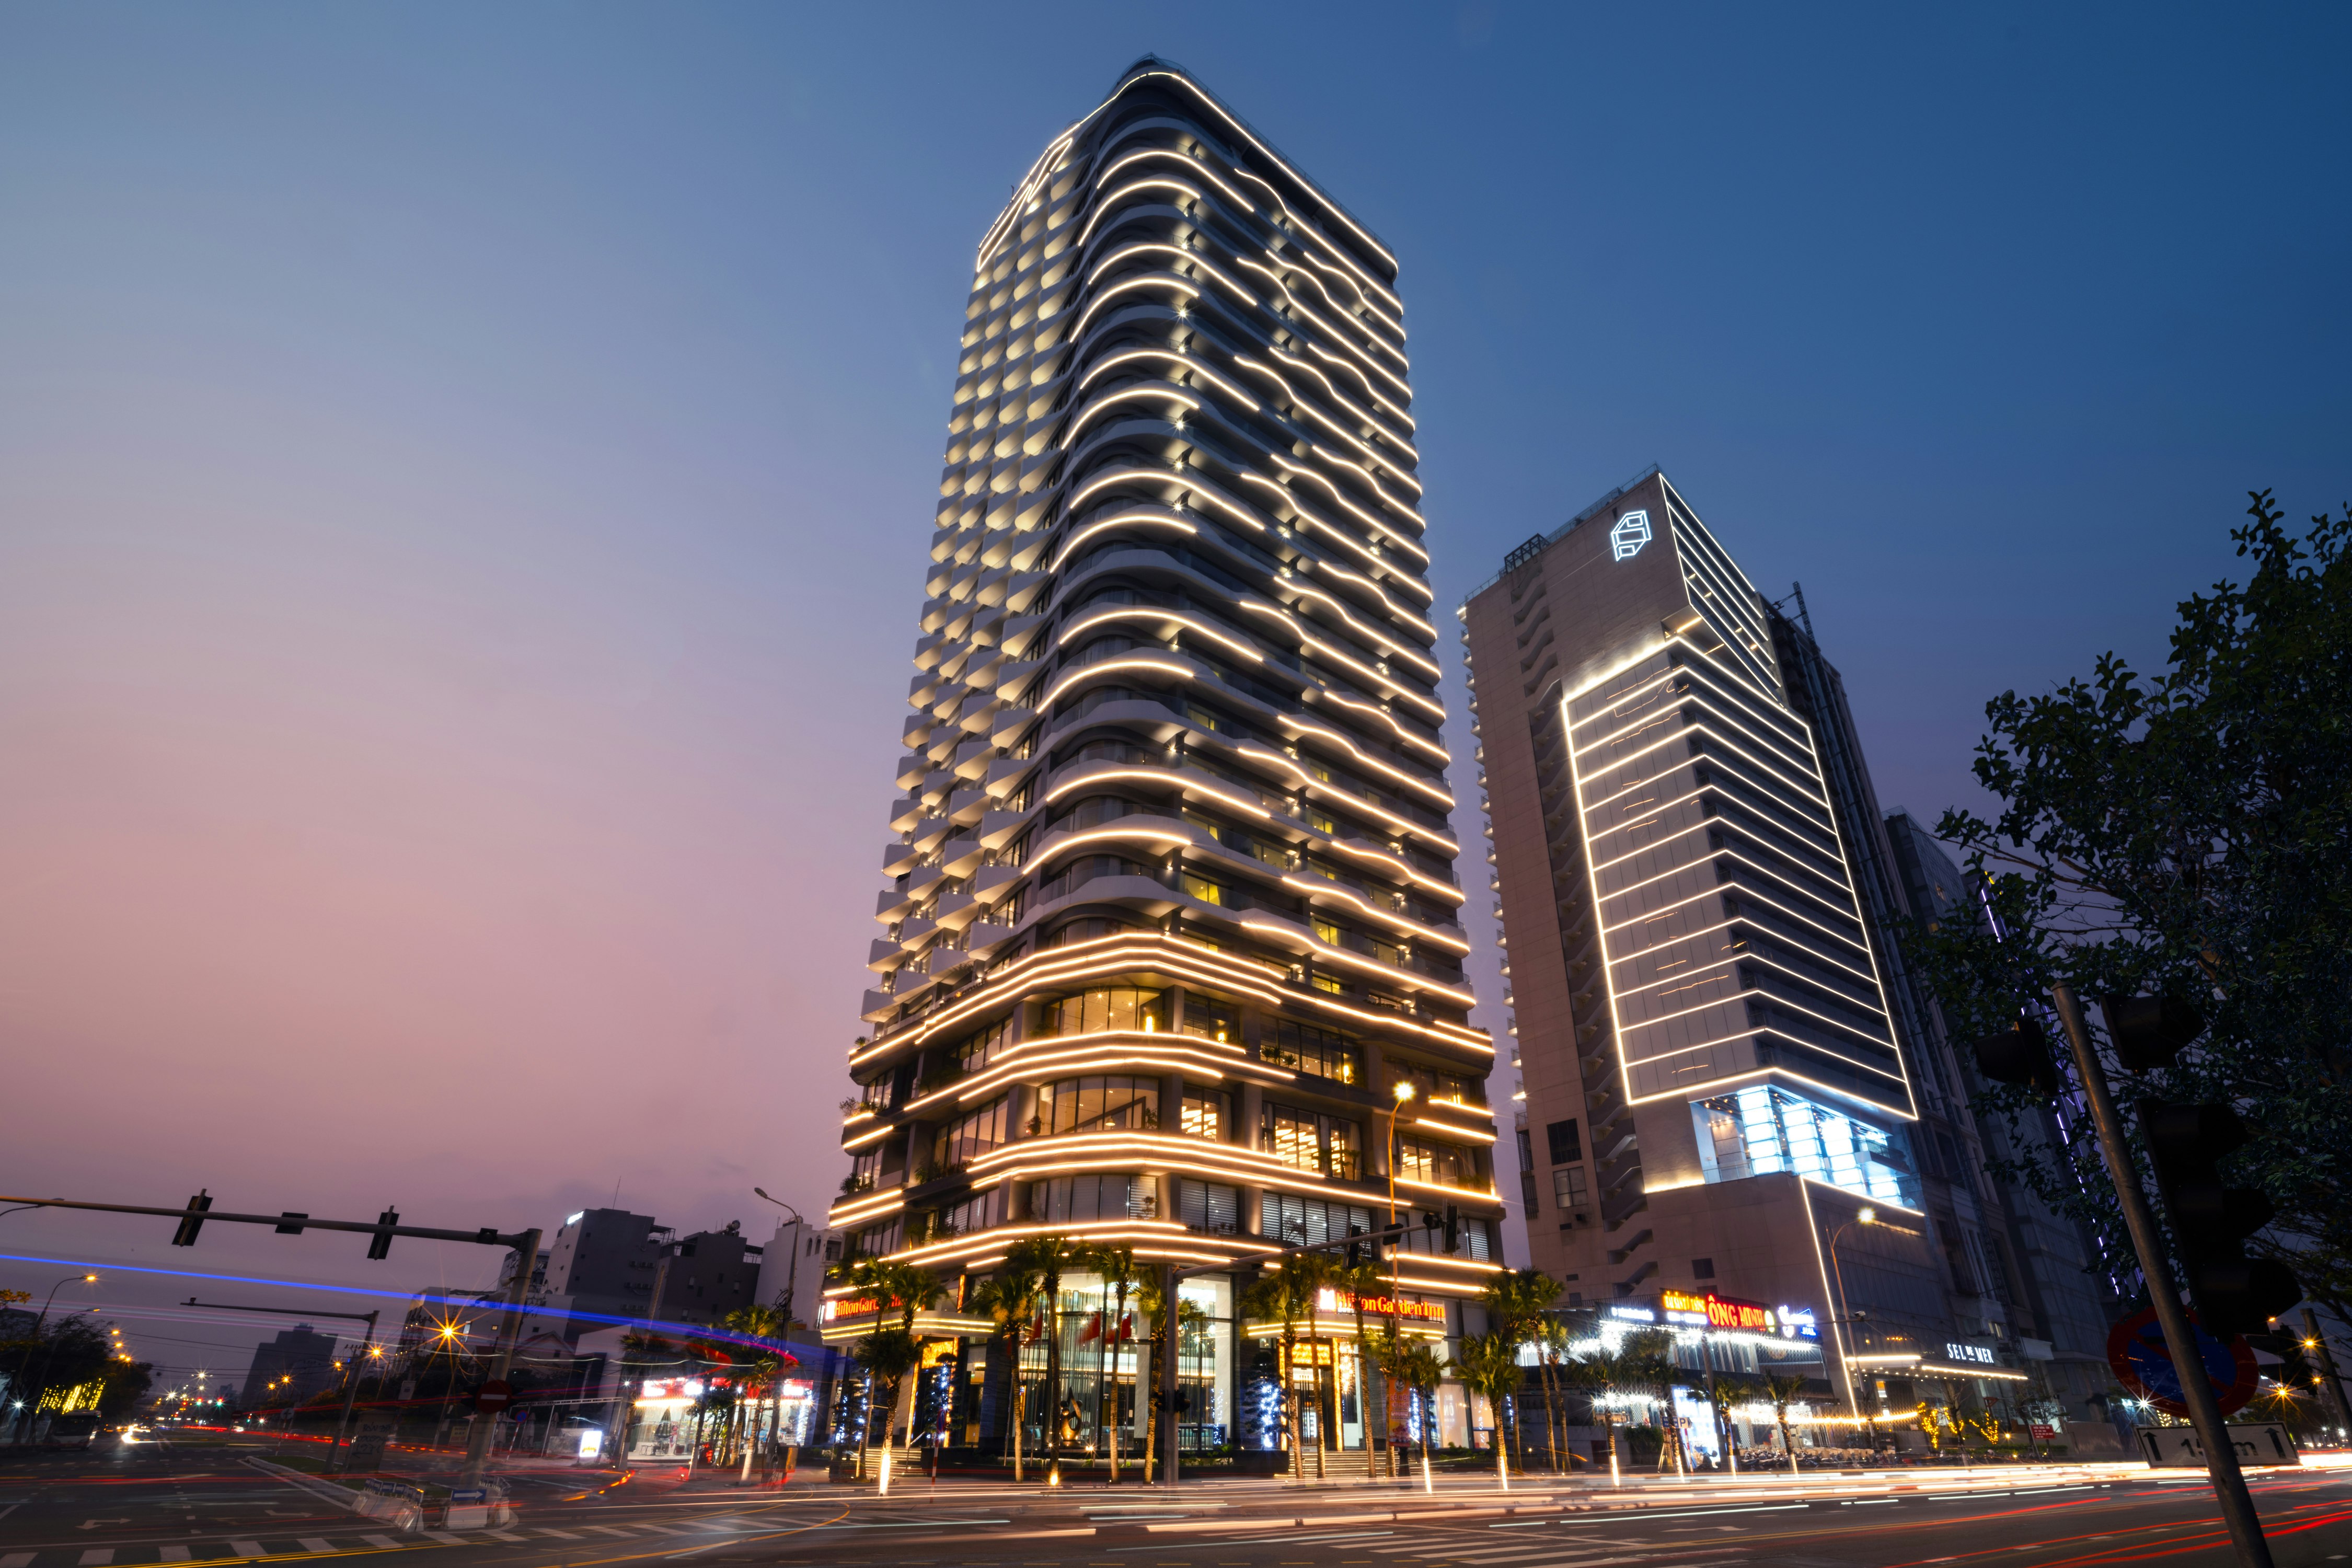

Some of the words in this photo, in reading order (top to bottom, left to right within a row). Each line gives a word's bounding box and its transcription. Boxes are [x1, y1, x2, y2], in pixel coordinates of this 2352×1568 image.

[835, 1300, 859, 1316] Hilton
[1337, 1292, 1377, 1311] Hilon
[1378, 1296, 1422, 1315] Gaden
[1424, 1301, 1445, 1318] Inn
[1708, 1295, 1738, 1327] ÔNG
[1738, 1306, 1765, 1327] MINH
[1947, 1343, 1966, 1360] SEL
[1965, 1346, 1974, 1356] DE
[1974, 1347, 1994, 1363] MER
[1680, 1418, 1686, 1427] P
